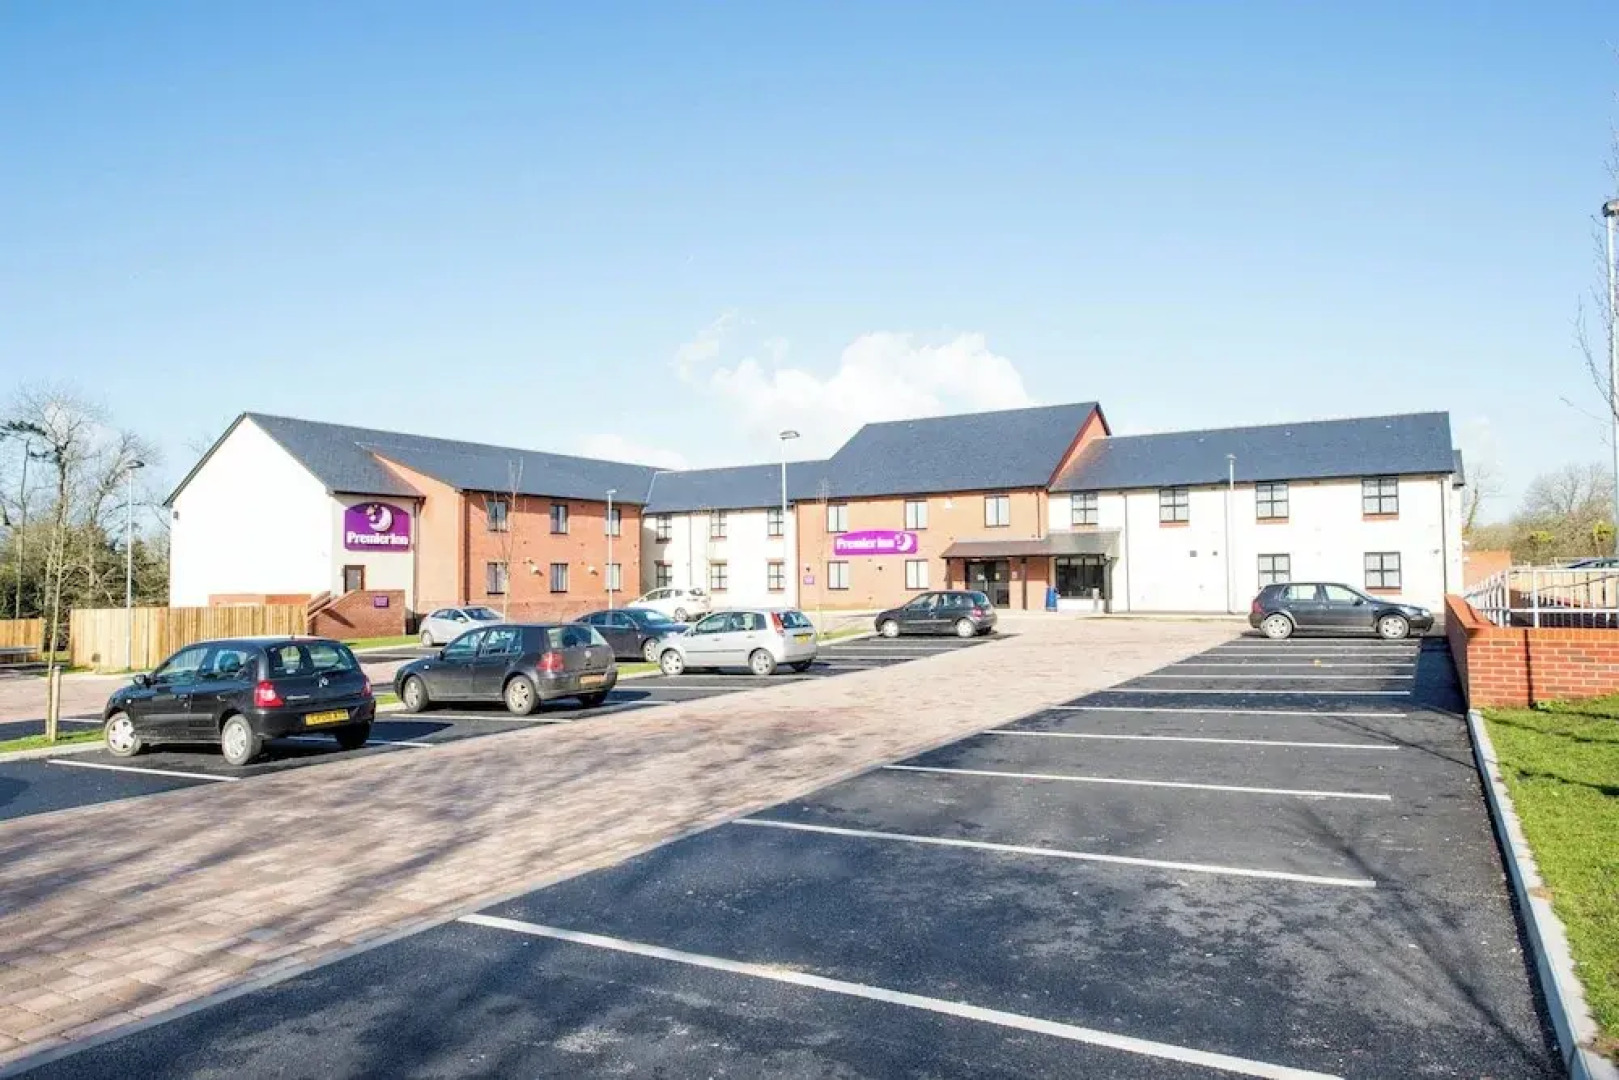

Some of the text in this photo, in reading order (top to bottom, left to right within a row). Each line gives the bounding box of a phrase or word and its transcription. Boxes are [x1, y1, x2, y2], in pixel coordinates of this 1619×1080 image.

[346, 531, 409, 545] Premier Inn
[836, 538, 875, 550] Premier
